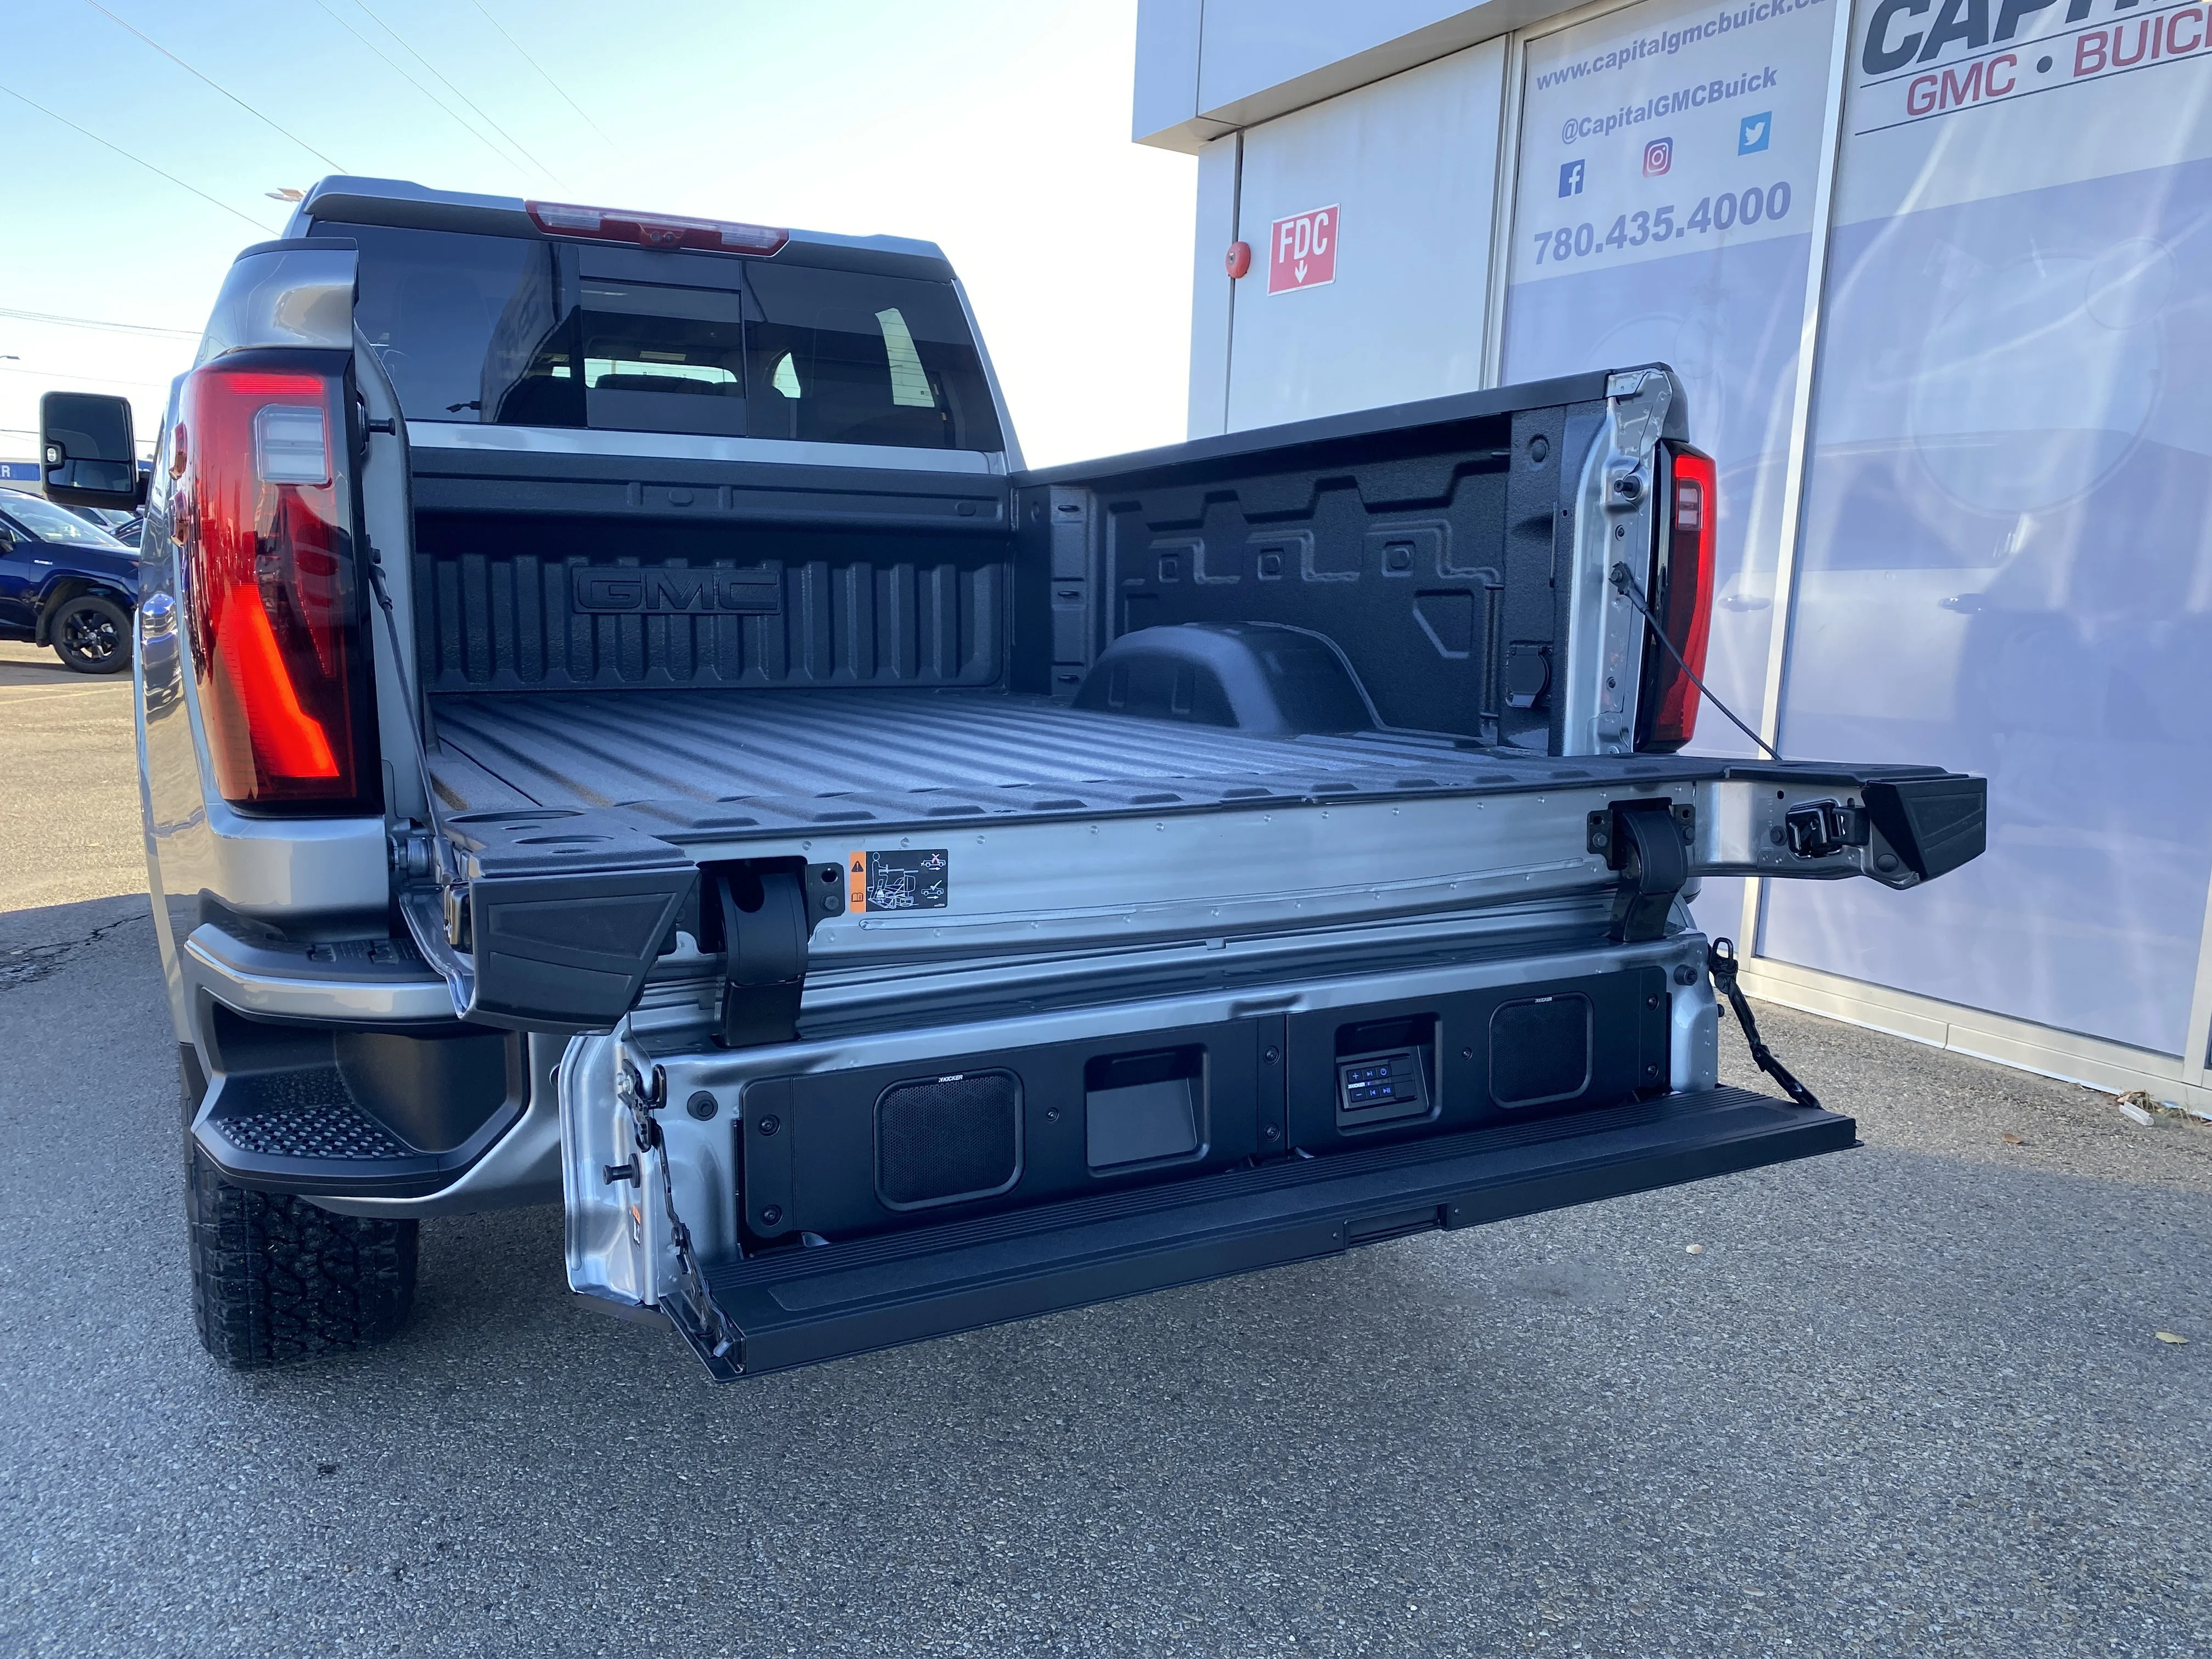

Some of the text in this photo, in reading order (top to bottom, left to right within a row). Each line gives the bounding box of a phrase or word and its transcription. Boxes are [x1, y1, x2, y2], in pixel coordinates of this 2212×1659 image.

[1536, 0, 1826, 90] www.capitalgmcbuick.
[1906, 5, 2212, 116] GMC BUIC
[1562, 66, 1778, 144] @CapitalGMCBuick
[1279, 212, 1329, 263] FDC
[1534, 181, 1791, 265] 780.435.4000
[577, 571, 778, 610] GMC
